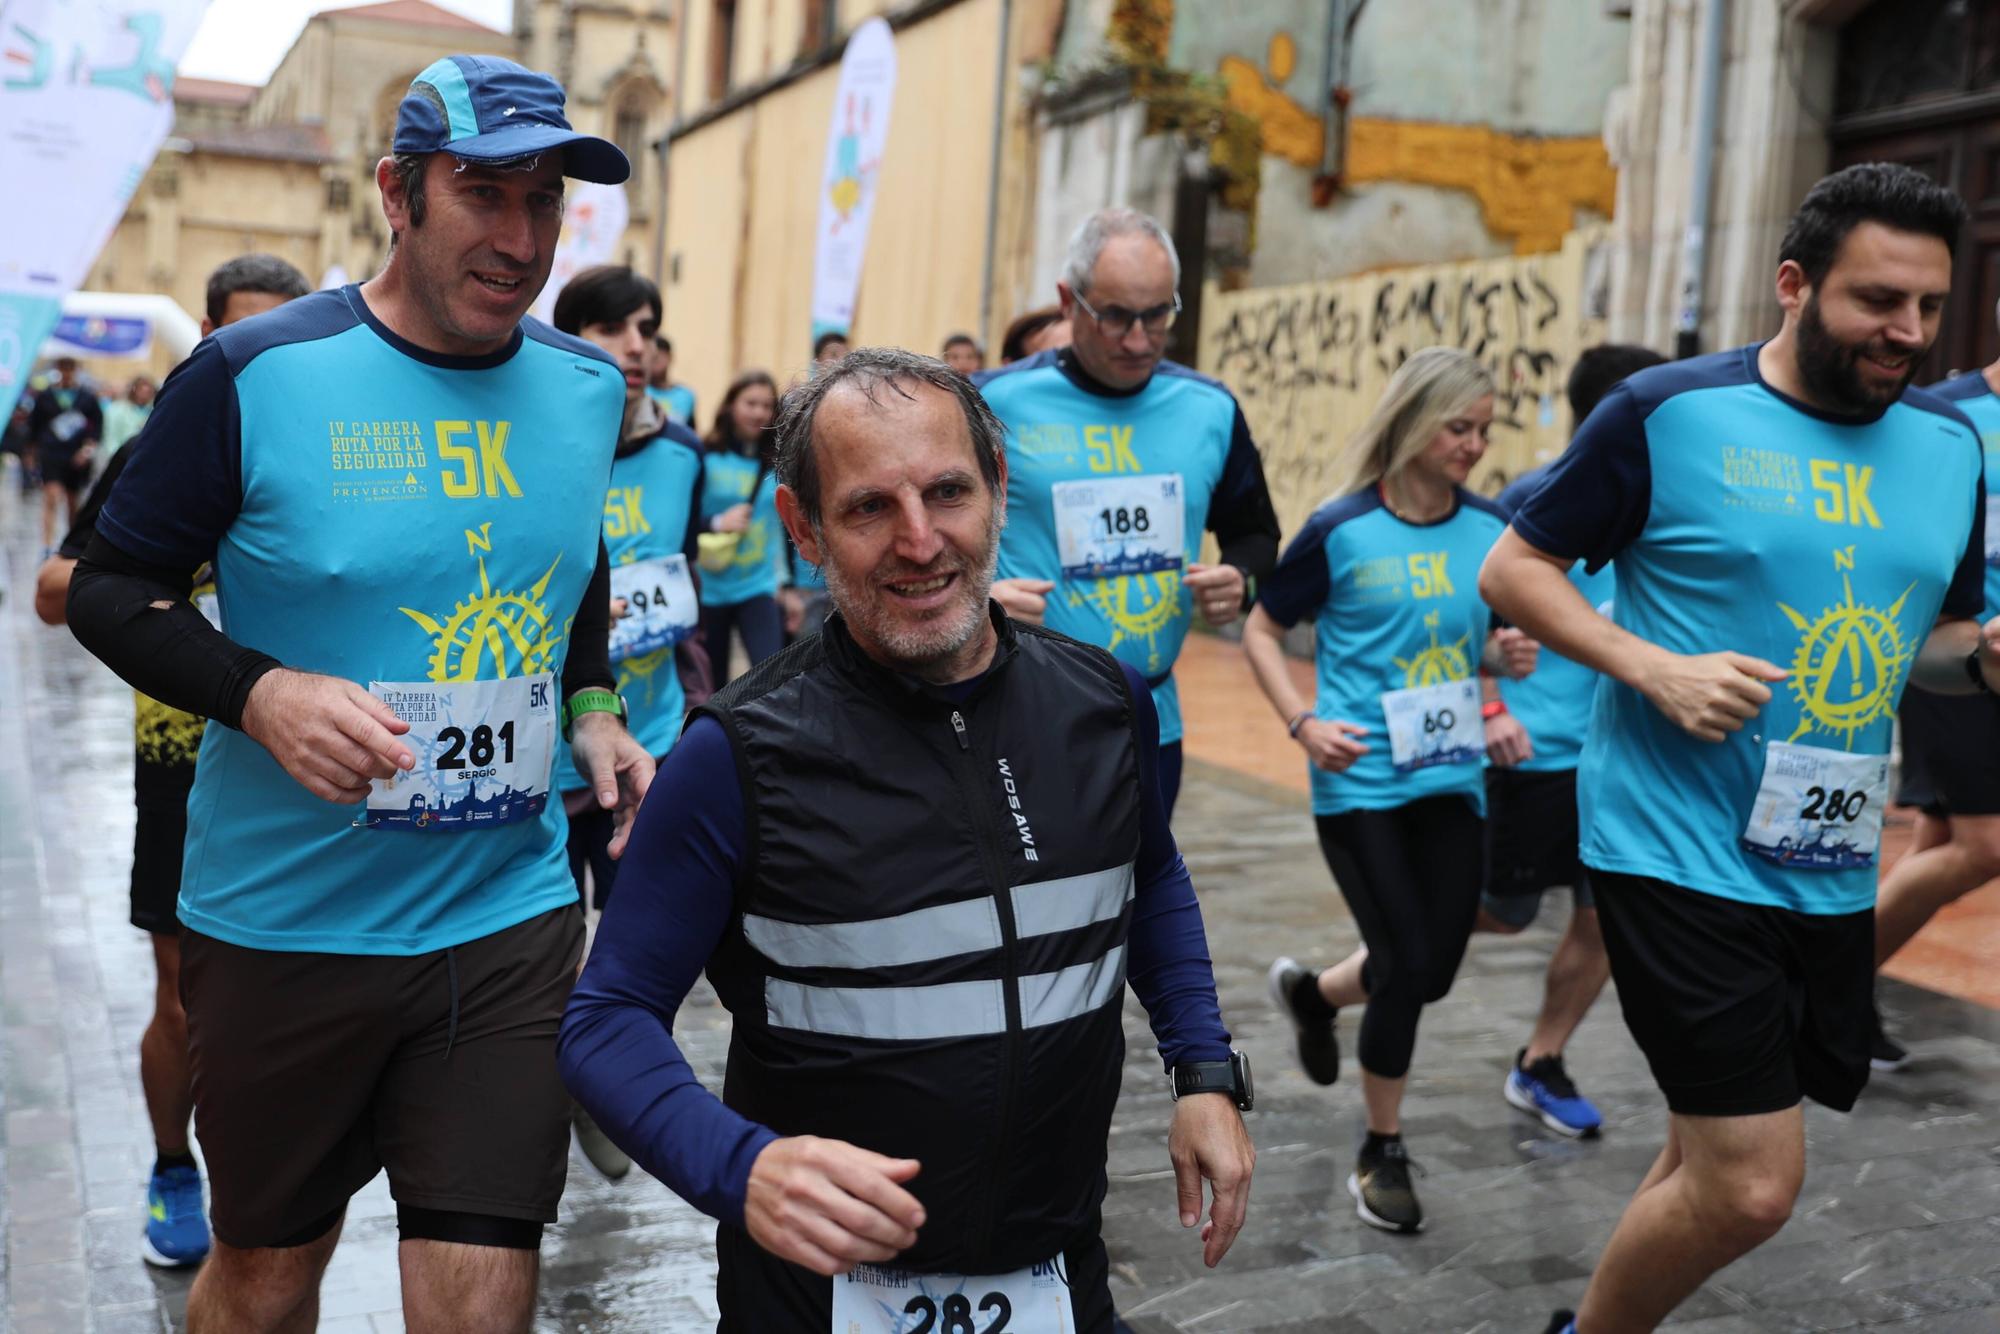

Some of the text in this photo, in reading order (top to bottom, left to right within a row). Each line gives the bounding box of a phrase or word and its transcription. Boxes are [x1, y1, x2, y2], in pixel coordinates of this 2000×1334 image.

[329, 421, 421, 436] IV CARRERA
[332, 436, 423, 452] RUTA POR LA
[332, 452, 428, 470] SEGURIDAD
[434, 419, 524, 499] 5K
[1084, 425, 1142, 473] 5K
[1809, 457, 1884, 530] 5K
[605, 486, 651, 537] 5K
[1099, 506, 1149, 535] 188
[464, 521, 493, 556] N
[1408, 550, 1455, 599] 5K
[383, 692, 436, 702] IV CARRERA
[408, 702, 423, 712] POR
[426, 702, 436, 712] LA
[531, 682, 549, 708] 5K
[1423, 709, 1455, 734] 60
[436, 720, 515, 770] 281
[457, 768, 497, 780] SERGIO
[1801, 786, 1867, 822] 280
[903, 1291, 1013, 1334] 282
